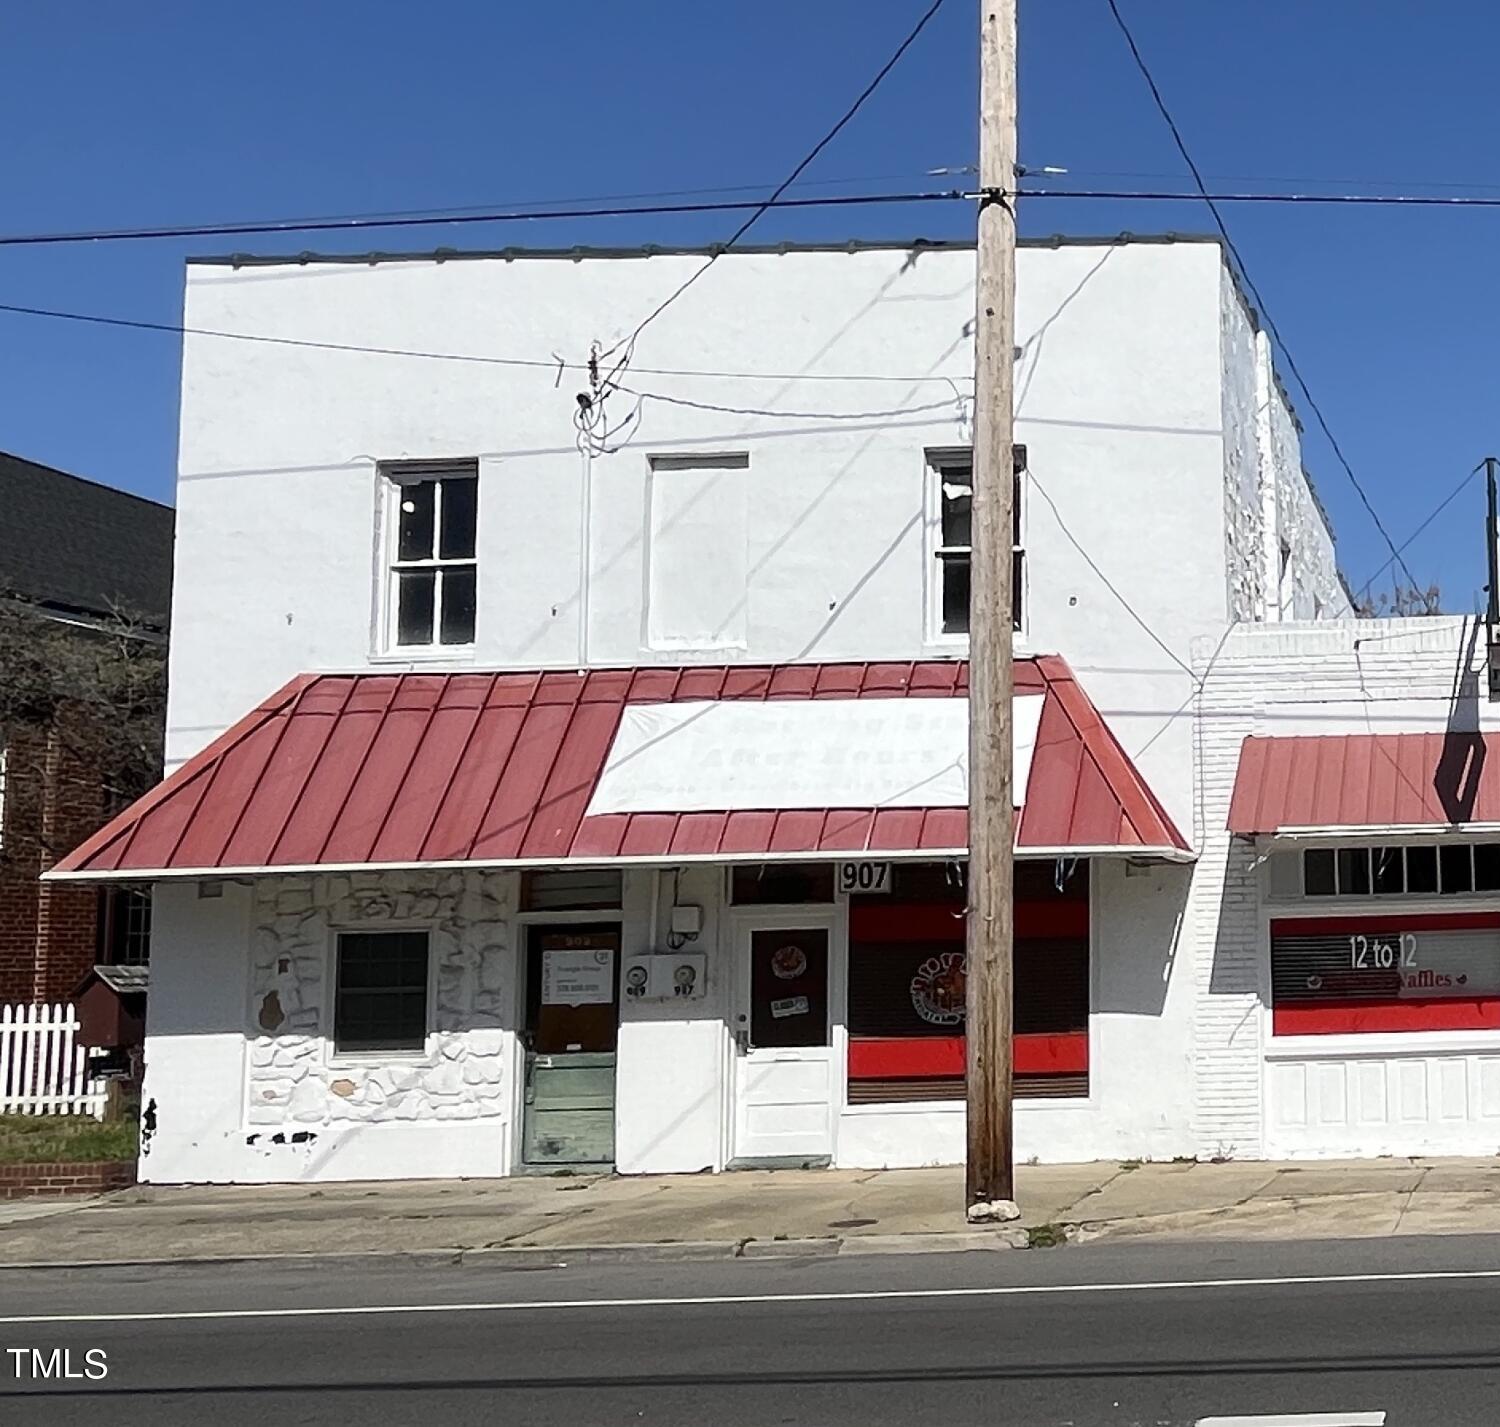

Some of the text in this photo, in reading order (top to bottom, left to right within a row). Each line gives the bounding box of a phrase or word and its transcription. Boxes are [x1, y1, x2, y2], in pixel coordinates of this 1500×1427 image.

[843, 862, 887, 889] 907
[1350, 933, 1417, 969] 12 to 12
